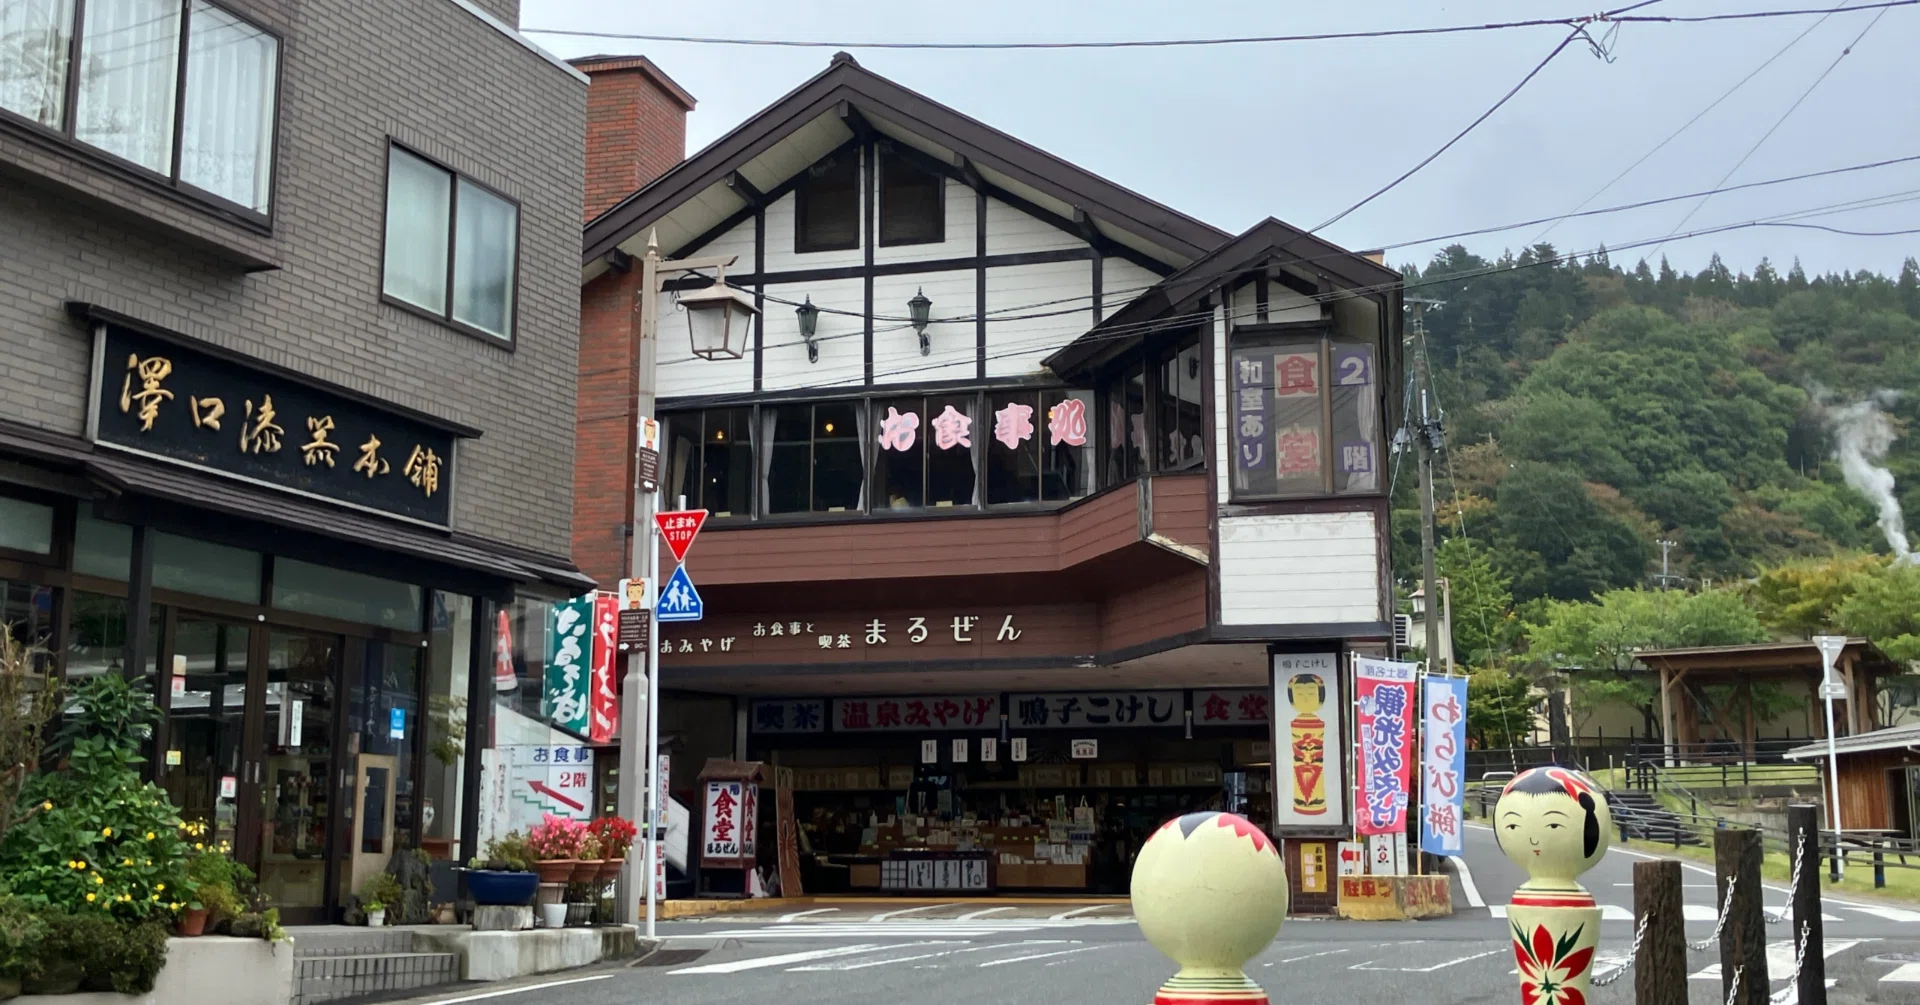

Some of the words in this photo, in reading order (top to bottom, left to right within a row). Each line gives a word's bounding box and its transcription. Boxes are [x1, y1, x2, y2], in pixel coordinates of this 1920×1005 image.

[878, 398, 1087, 451] お食事処
[1239, 360, 1264, 468] 和室あり
[1276, 355, 1318, 475] 食堂
[1340, 356, 1369, 471] 2階
[664, 517, 697, 530] 止まれ
[669, 530, 692, 541] STOP
[753, 621, 815, 637] お食事と
[818, 634, 851, 650] 喫茶
[865, 614, 1021, 645] まるぜん
[660, 636, 735, 654] おみやげ
[756, 703, 819, 729] 喫茶
[842, 697, 995, 729] 温泉みやげ
[1019, 694, 1174, 726] 鳴子こけし
[1203, 692, 1268, 721] 食堂
[533, 747, 589, 762] お食事
[559, 771, 587, 787] 2階
[712, 788, 738, 842] 食堂
[707, 842, 739, 855] まるぜん
